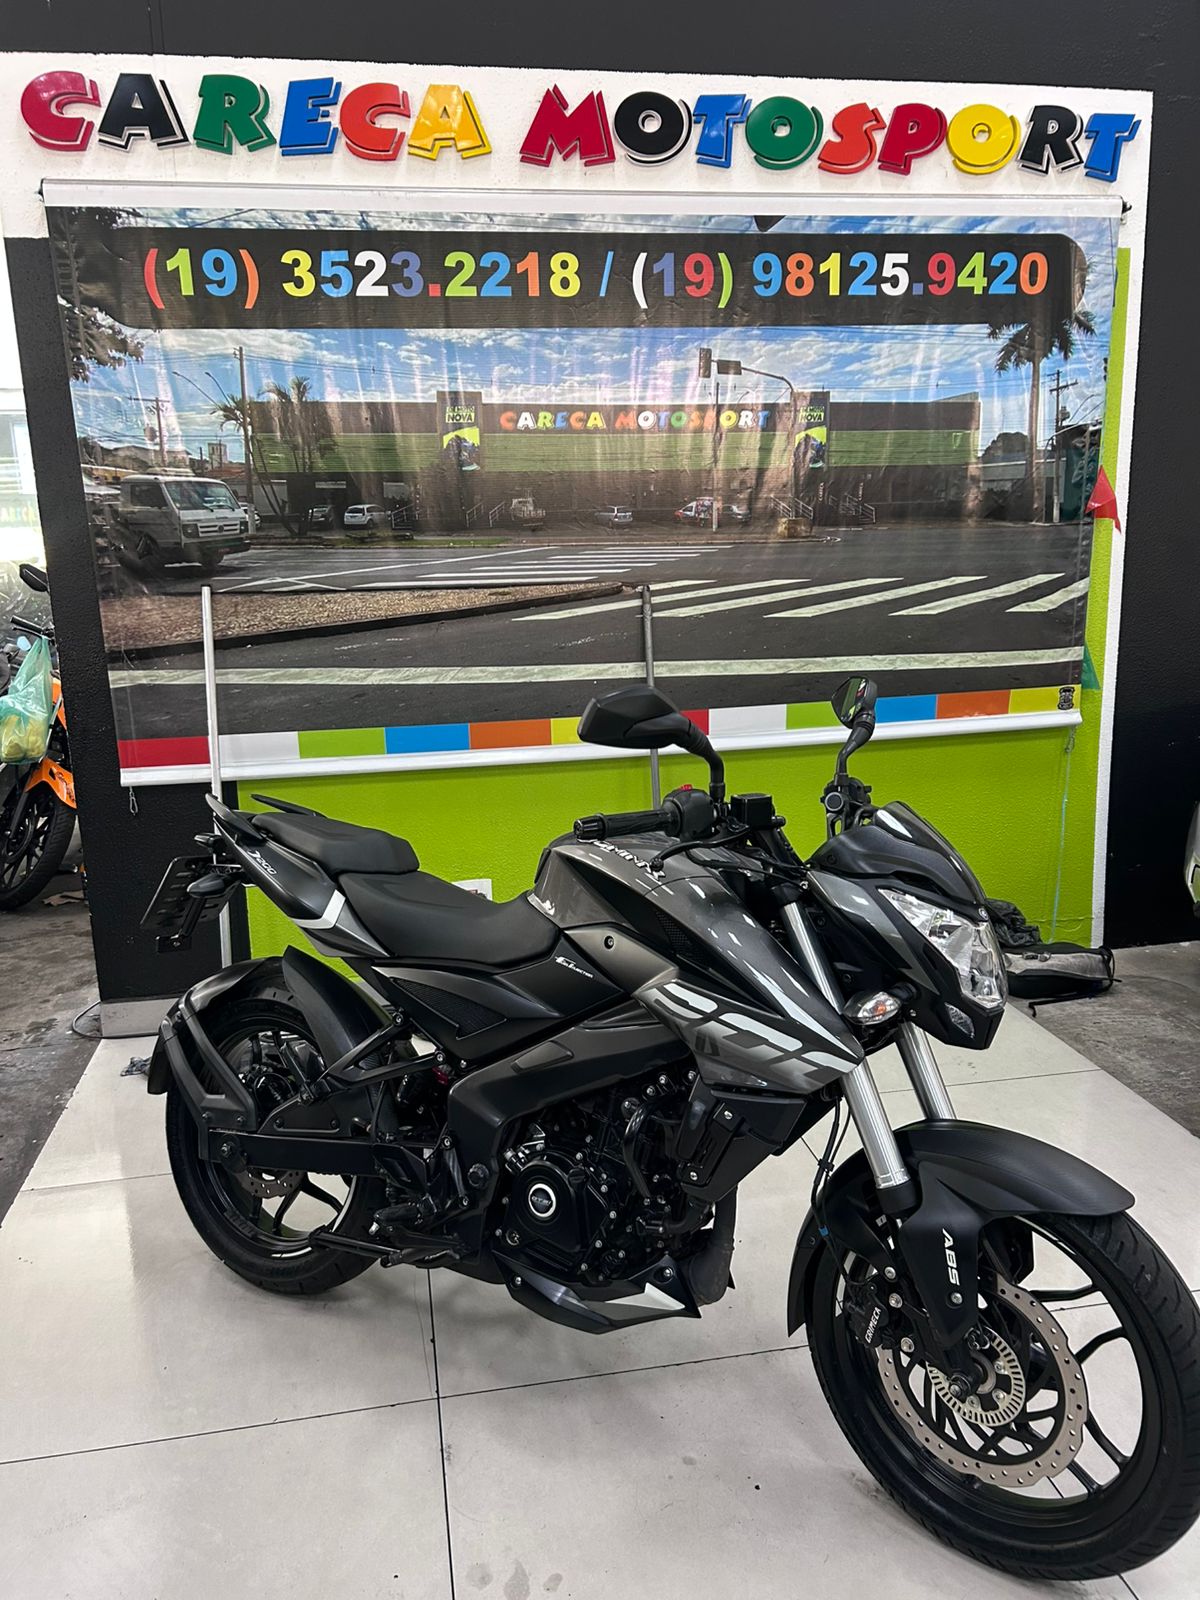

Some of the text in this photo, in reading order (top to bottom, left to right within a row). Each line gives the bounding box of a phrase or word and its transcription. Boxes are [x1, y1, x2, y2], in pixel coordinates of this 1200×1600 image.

[20, 69, 1142, 183] CARECA MOTOSPORT
[143, 247, 260, 310] (19)
[280, 249, 582, 298] 3523.2218
[632, 251, 735, 309] (19)
[752, 251, 1049, 297] 98125.9420
[446, 413, 474, 422] NOVA
[499, 410, 607, 431] CARECA
[942, 1227, 960, 1286] ABS
